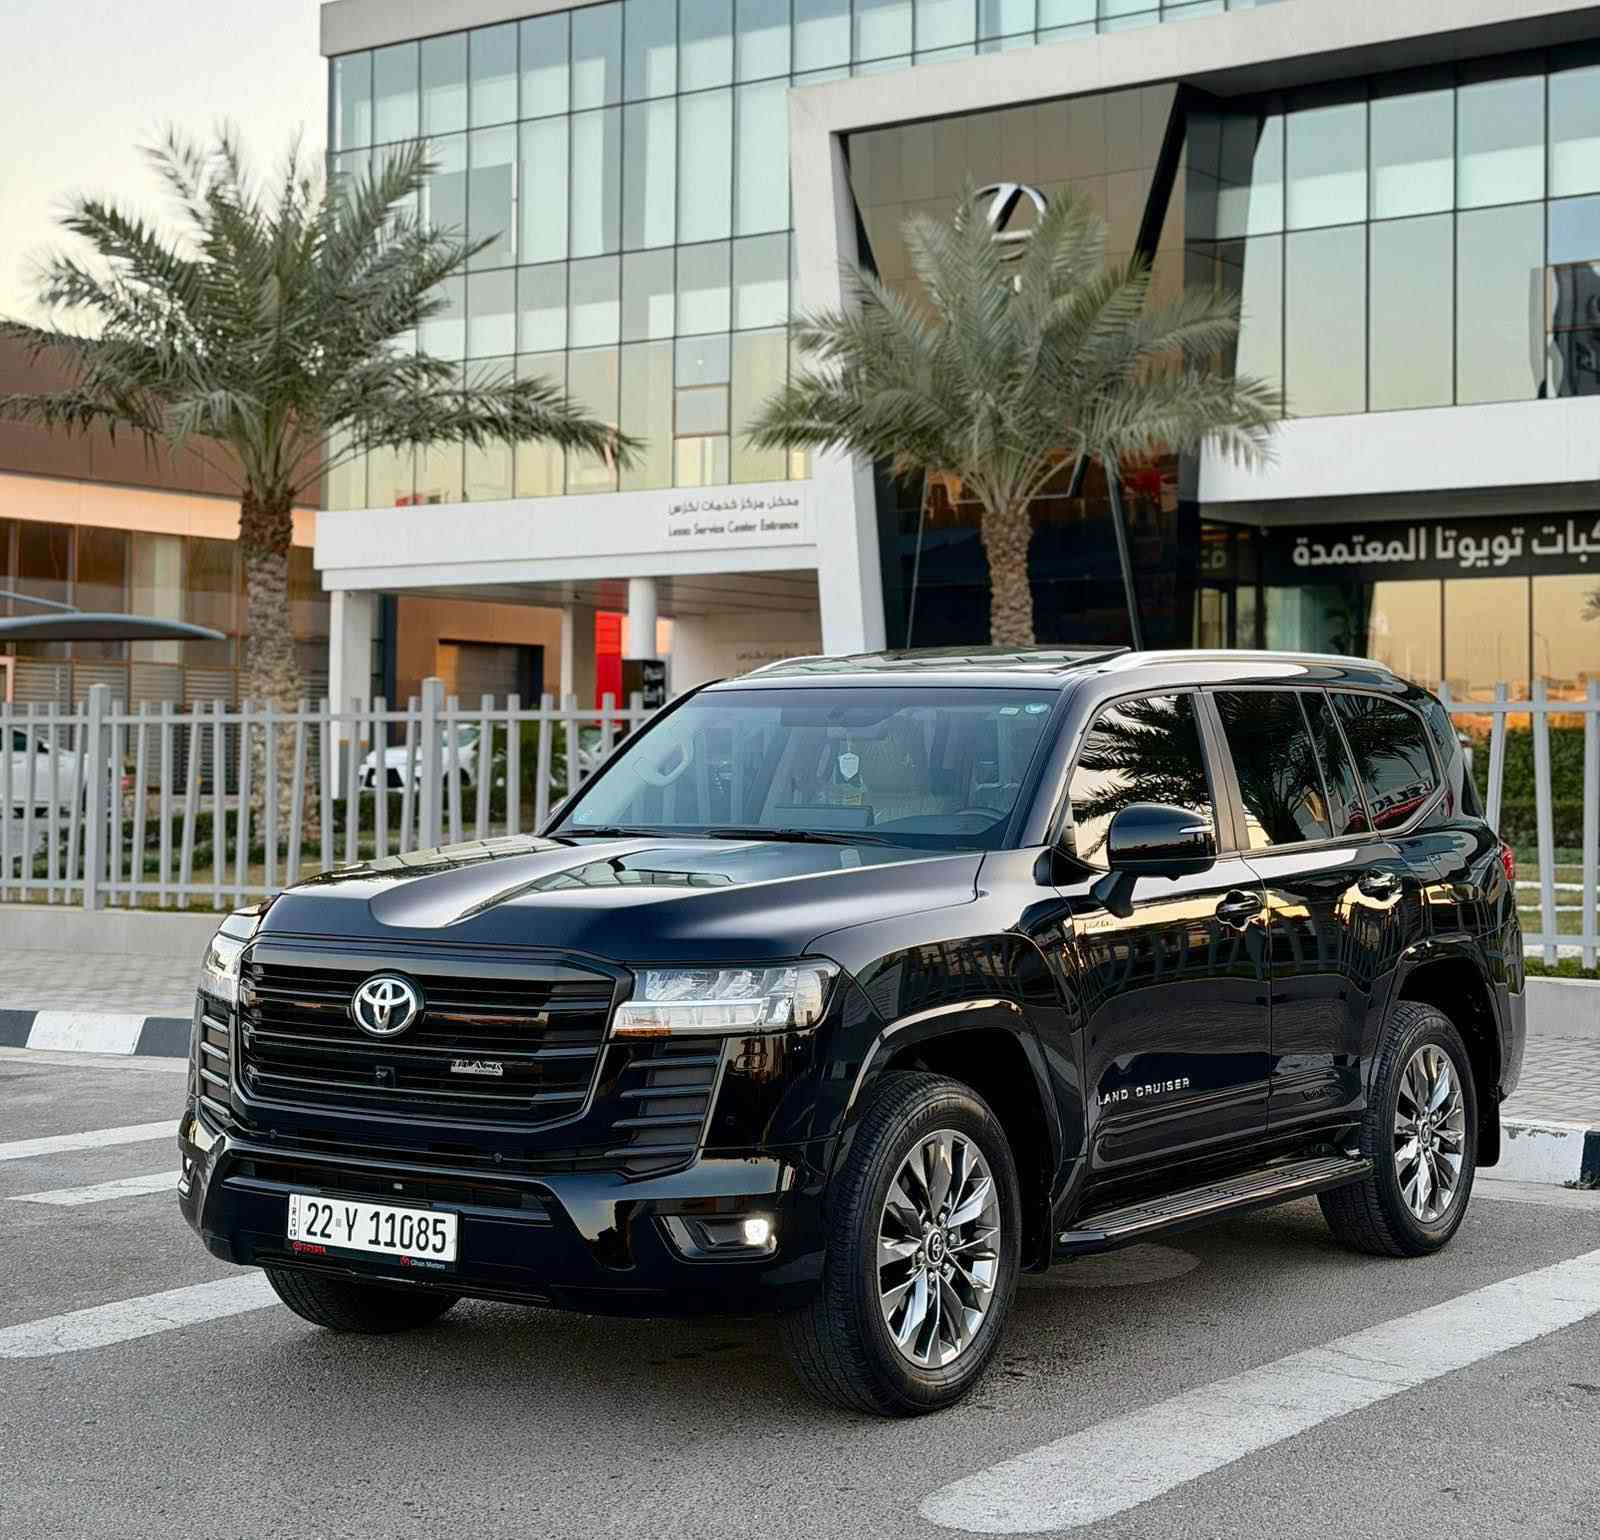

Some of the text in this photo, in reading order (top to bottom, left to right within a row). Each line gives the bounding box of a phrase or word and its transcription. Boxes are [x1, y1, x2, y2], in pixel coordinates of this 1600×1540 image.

[693, 522, 725, 536] Service
[727, 520, 757, 534] Center
[760, 518, 799, 532] Entrance
[1293, 526, 1427, 566] المعتمدة
[1435, 526, 1525, 568] تويوتا
[1097, 1077, 1190, 1106] LAND CRUISER
[306, 1202, 447, 1254] 22 Y 11085
